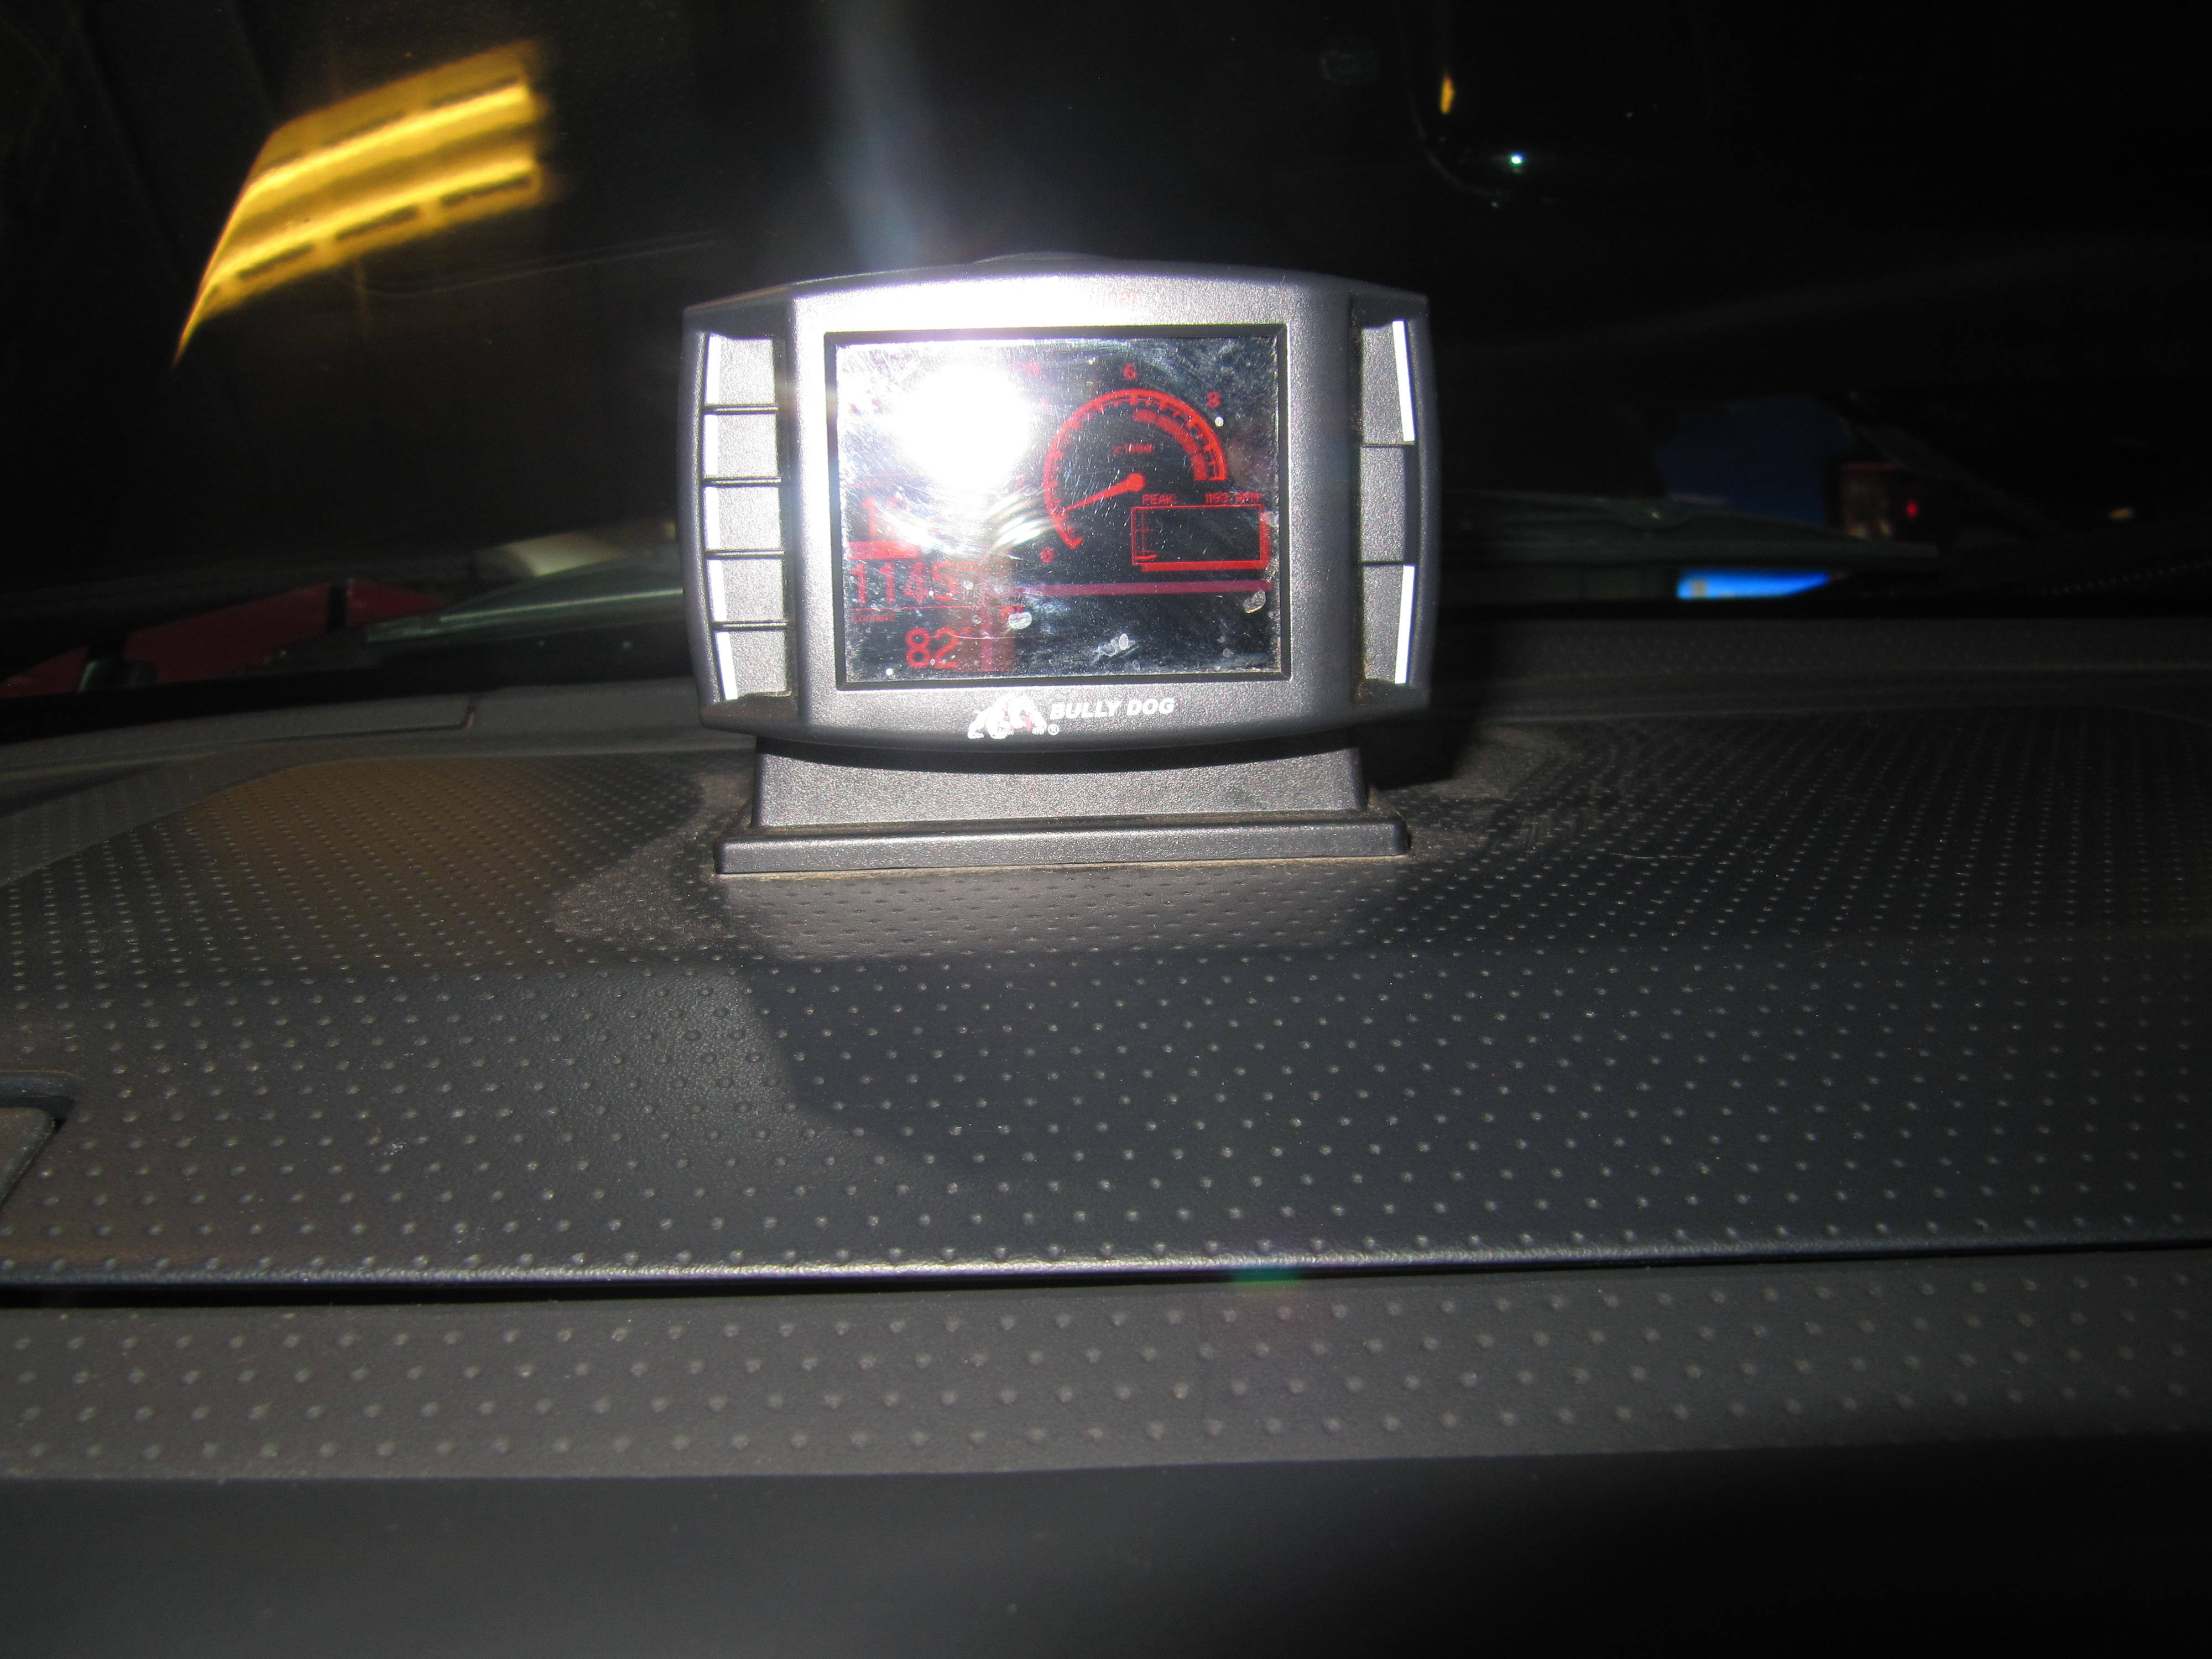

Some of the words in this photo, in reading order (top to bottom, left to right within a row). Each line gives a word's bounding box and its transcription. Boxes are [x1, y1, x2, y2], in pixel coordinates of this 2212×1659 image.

[1123, 363, 1138, 380] 6
[1207, 392, 1221, 409] 8
[851, 561, 958, 603] 1145
[905, 627, 959, 669] 82
[1050, 700, 1120, 719] BULLY
[1127, 697, 1175, 716] DOG
